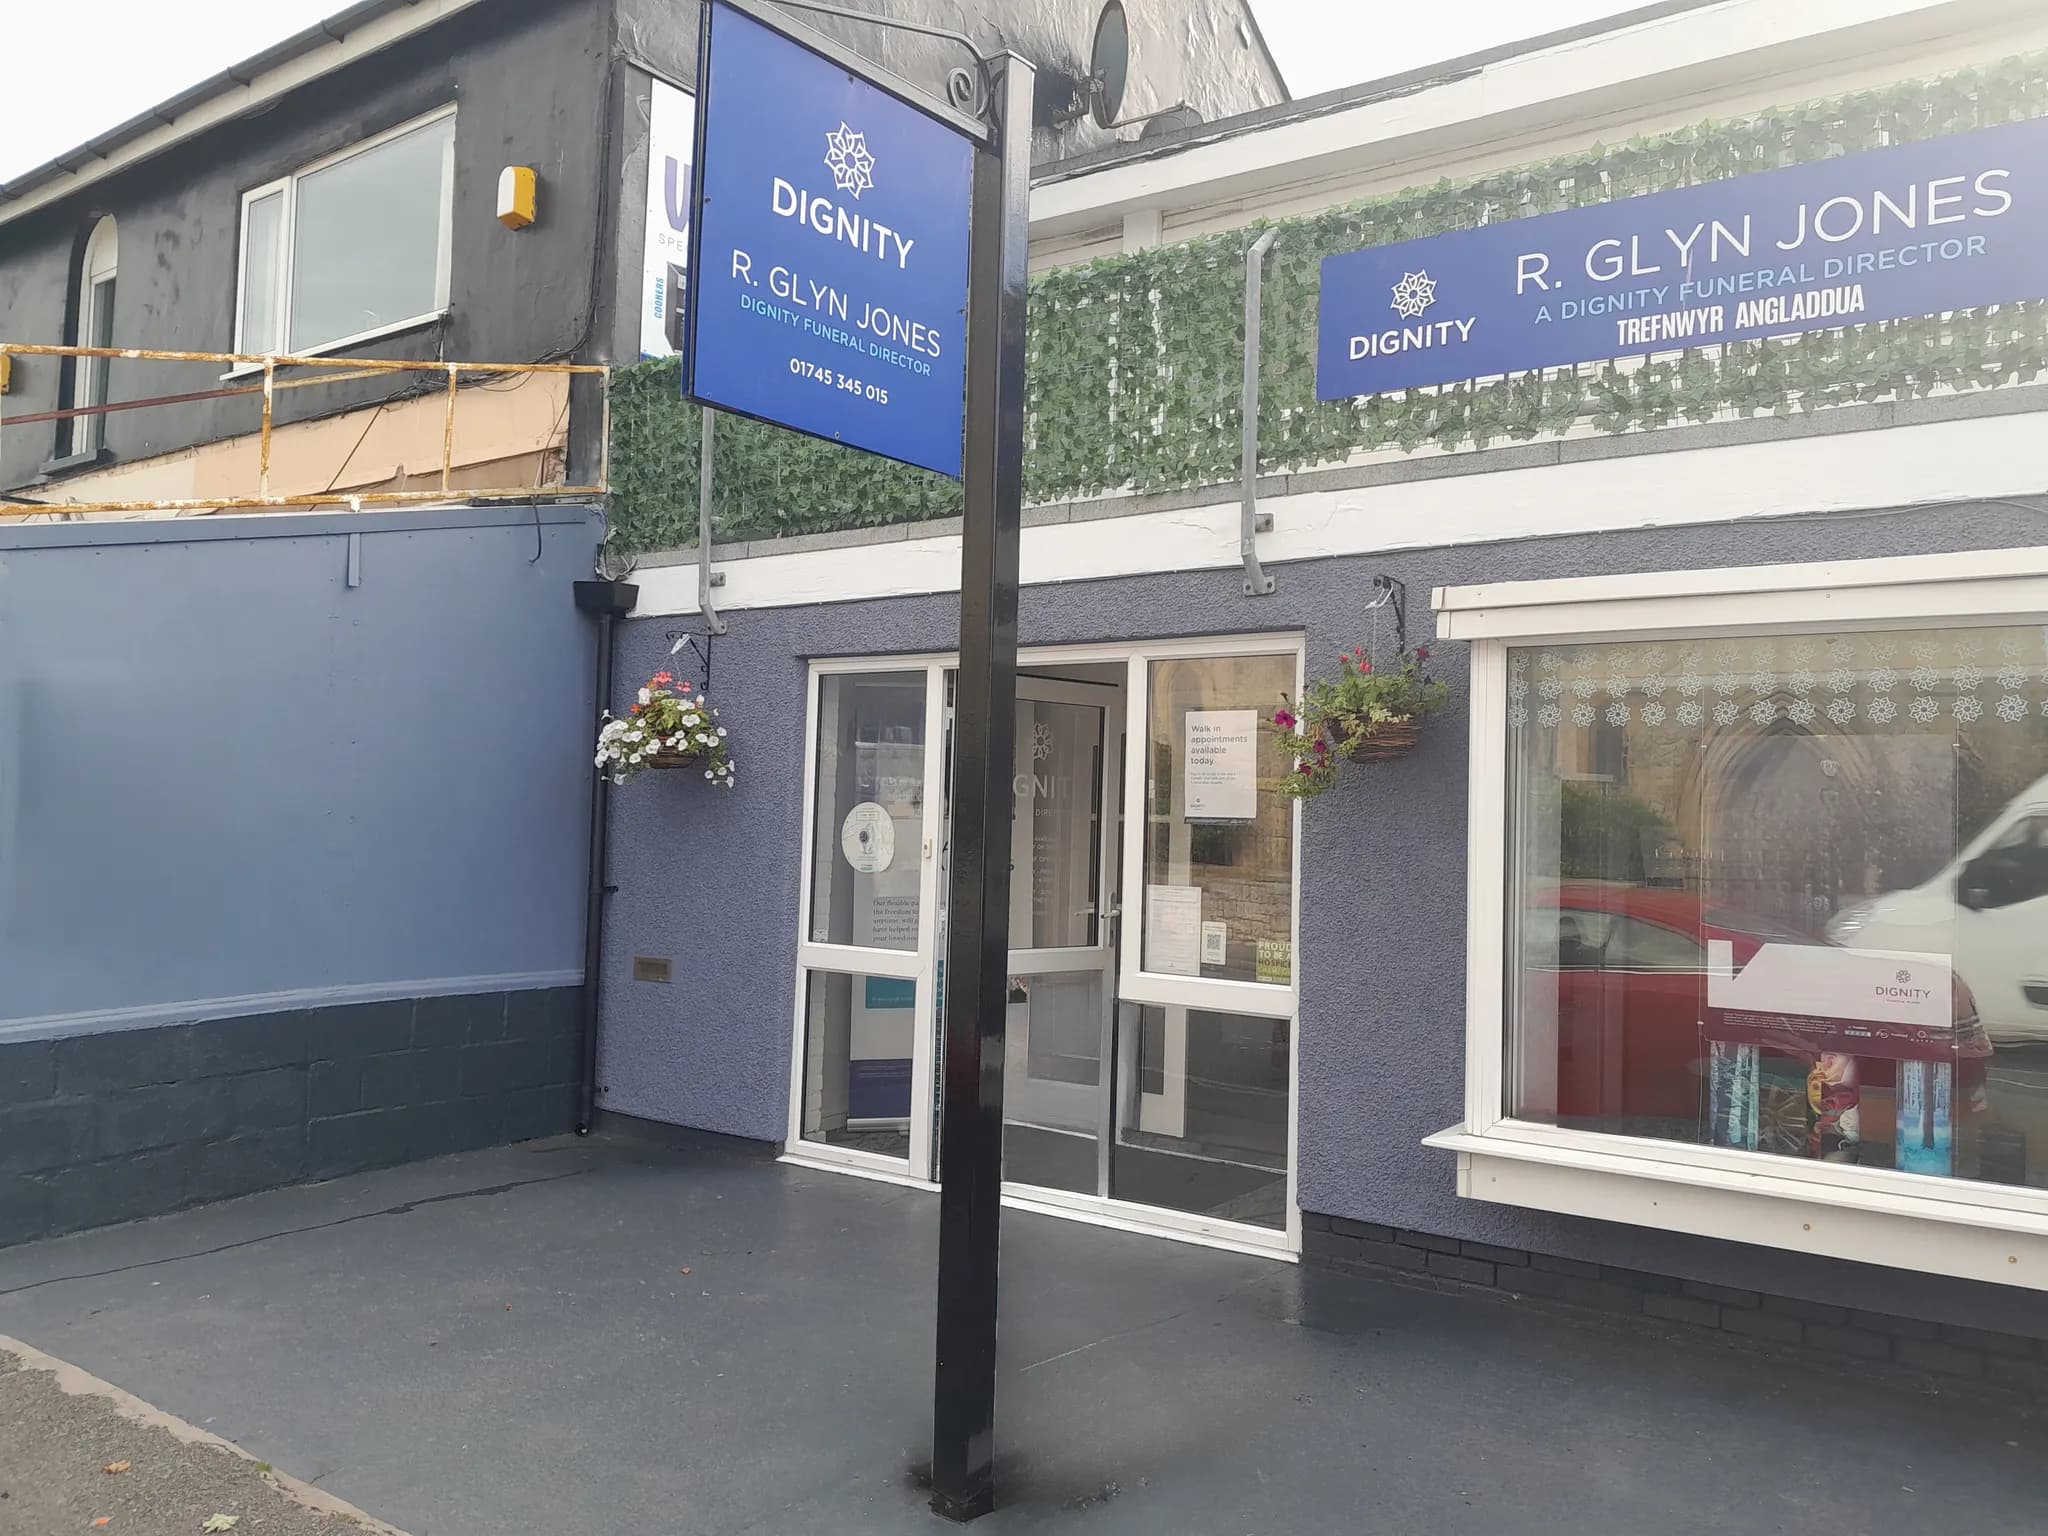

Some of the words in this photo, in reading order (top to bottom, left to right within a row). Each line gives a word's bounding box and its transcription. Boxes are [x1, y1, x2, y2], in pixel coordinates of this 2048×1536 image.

[658, 233, 686, 252] SPE
[772, 177, 916, 269] DIGNITY
[1516, 253, 1562, 295] R.
[1586, 215, 1751, 283] GLYN
[1776, 168, 2013, 252] JONES
[1534, 304, 1552, 324] A
[1561, 286, 1669, 320] DIGNITY
[1680, 261, 1815, 302] FUNERAL
[1824, 235, 1986, 280] DIRECTOR
[732, 249, 758, 288] R.
[769, 266, 848, 320] GLYN
[856, 301, 941, 358] JONES
[1616, 304, 1723, 347] TREFNWYR
[1735, 285, 1865, 329] ANGLADDUA
[740, 294, 800, 328] DIGNITY
[804, 318, 865, 353] FUNERAL
[869, 342, 931, 377] DIRECTOR
[1349, 317, 1477, 361] DIGNITY
[790, 358, 832, 385] 01745
[836, 374, 862, 396] 345
[866, 383, 888, 405] 015
[1191, 725, 1211, 733] Walk
[1213, 725, 1221, 733] in
[1191, 735, 1248, 744] appointments
[1191, 746, 1227, 754] available
[1876, 986, 1931, 999] DIGNITY
